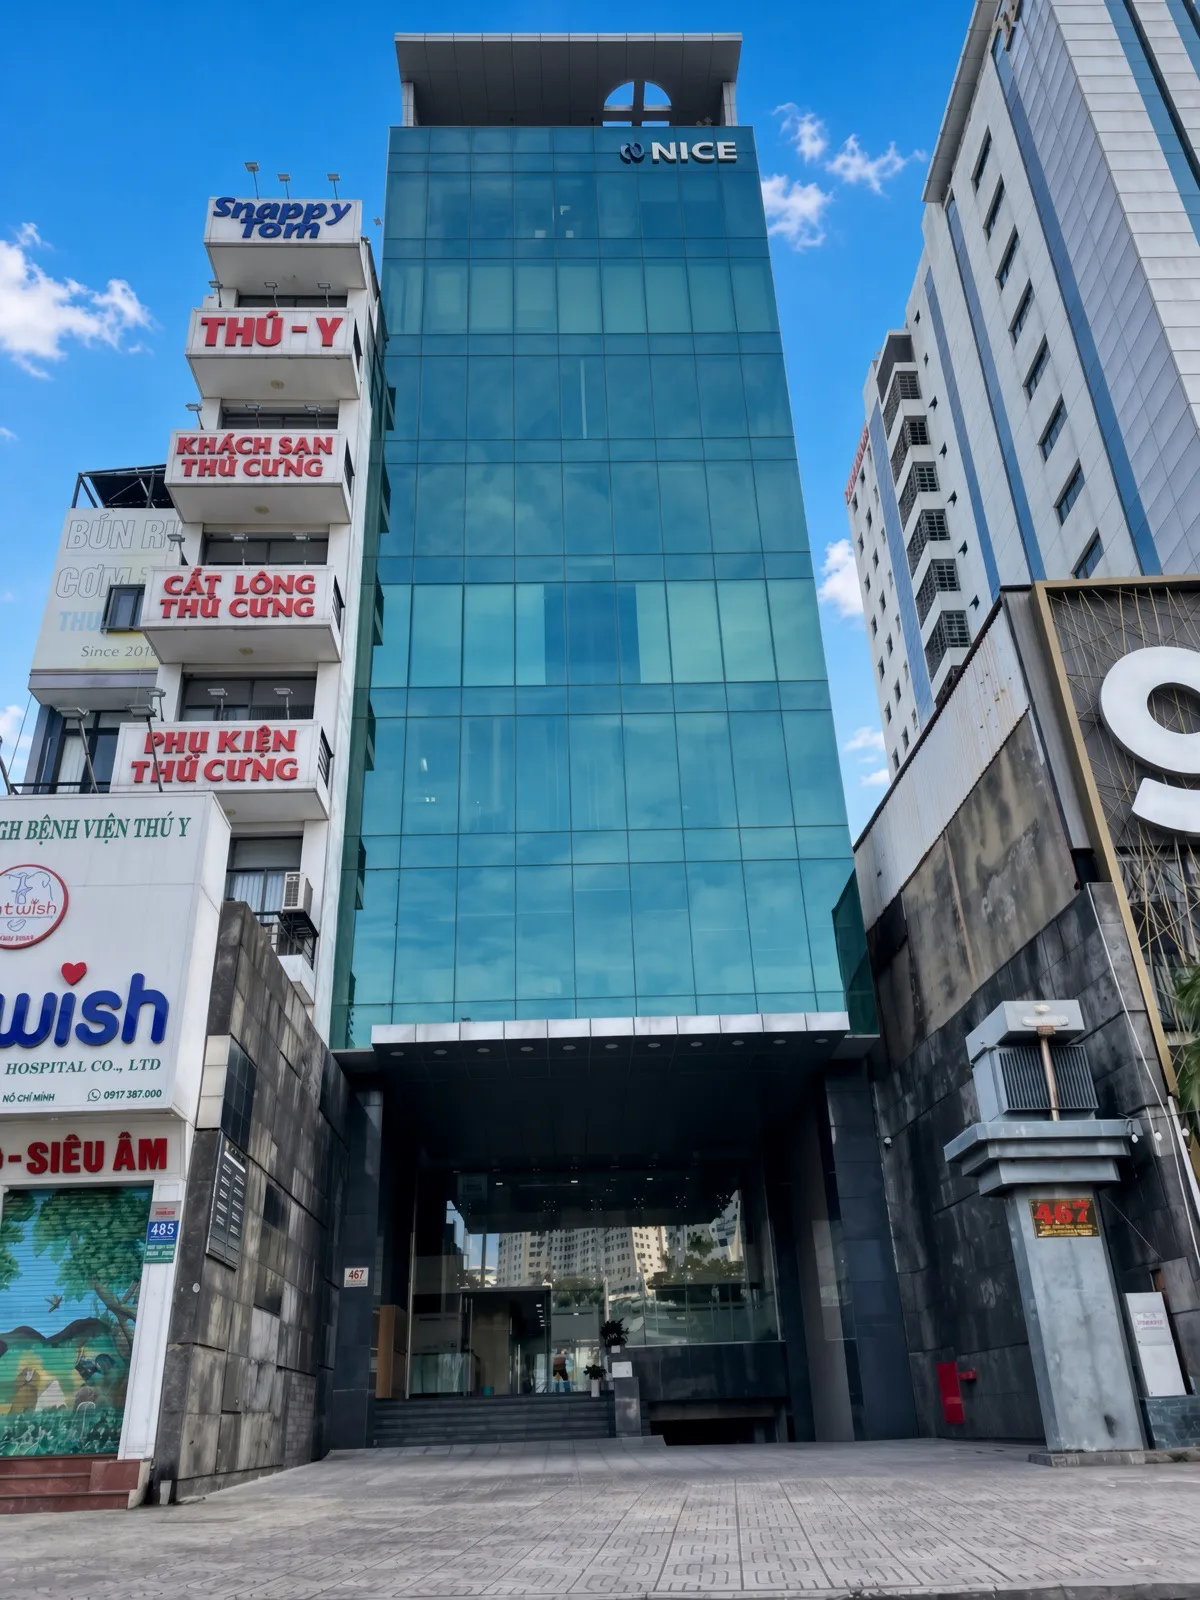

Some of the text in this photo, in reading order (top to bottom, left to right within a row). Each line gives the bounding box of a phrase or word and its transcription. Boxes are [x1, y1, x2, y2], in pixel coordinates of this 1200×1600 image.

[652, 142, 738, 161] NICE
[213, 197, 352, 226] Snappy
[240, 218, 321, 239] Tom
[176, 433, 272, 455] KHÁCH
[66, 513, 135, 549] BÚN
[234, 571, 316, 595] LÔNG
[229, 597, 315, 618] CƯNG
[81, 646, 119, 657] Since
[217, 725, 297, 758] KIỆN
[203, 757, 299, 782] CƯNG
[25, 814, 80, 845] BỆNH
[84, 813, 130, 844] VIỆN
[134, 811, 175, 838] THÚ
[178, 817, 191, 837] Y
[5, 1061, 86, 1075] HOSPITAL
[128, 1058, 161, 1071] LTD
[104, 1089, 162, 1099] 0917 387.000
[113, 1132, 168, 1171] ÂM
[1035, 1200, 1090, 1225] 467
[151, 1223, 174, 1235] 485
[349, 1270, 364, 1280] 467
